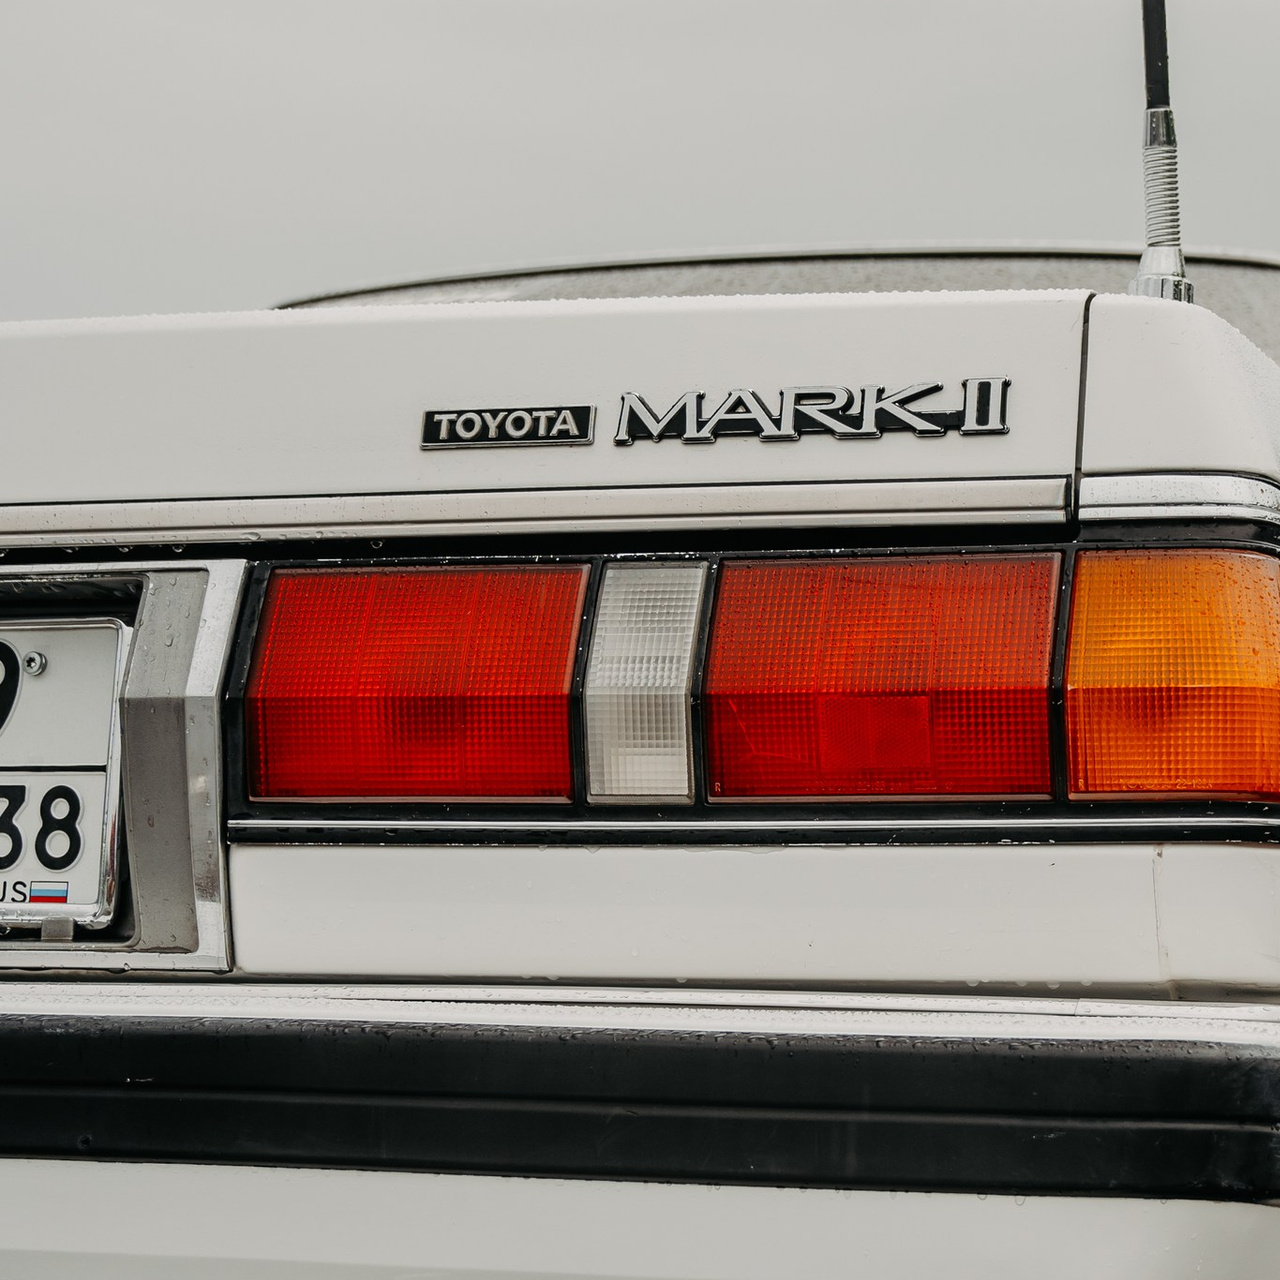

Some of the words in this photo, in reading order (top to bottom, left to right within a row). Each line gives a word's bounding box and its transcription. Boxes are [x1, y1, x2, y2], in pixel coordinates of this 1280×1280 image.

[433, 409, 580, 441] TOYOTA
[613, 382, 945, 446] MARK
[960, 375, 1012, 436] II
